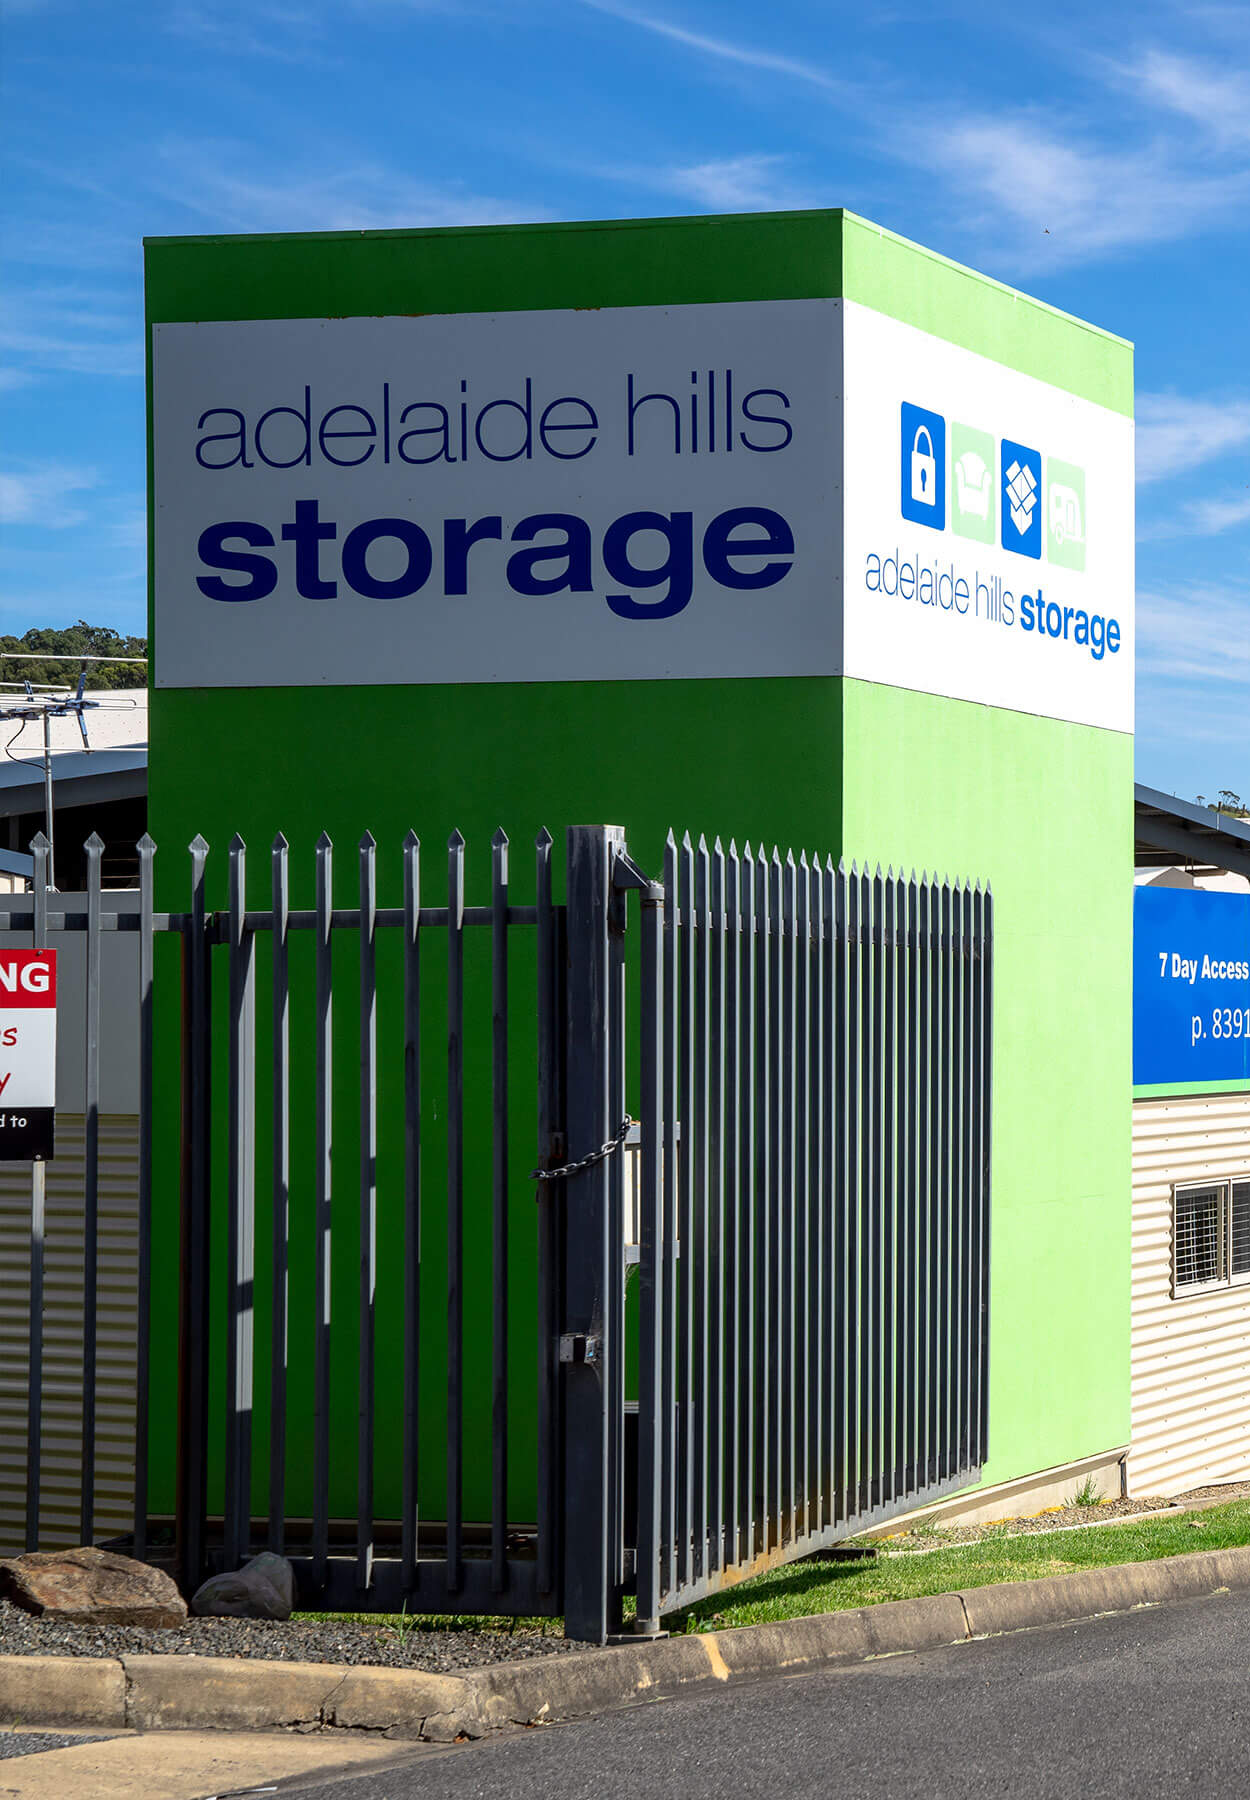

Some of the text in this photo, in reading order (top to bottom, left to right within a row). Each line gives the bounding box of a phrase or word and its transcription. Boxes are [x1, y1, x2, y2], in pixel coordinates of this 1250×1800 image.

[195, 368, 793, 470] adelaide hills
[195, 499, 795, 620] storage
[865, 547, 1121, 660] adelaide hills storage
[1159, 952, 1168, 977] 7
[1171, 952, 1198, 985] Day
[1201, 954, 1249, 980] Access
[1191, 1015, 1207, 1047] p.
[10, 1115, 27, 1128] to
